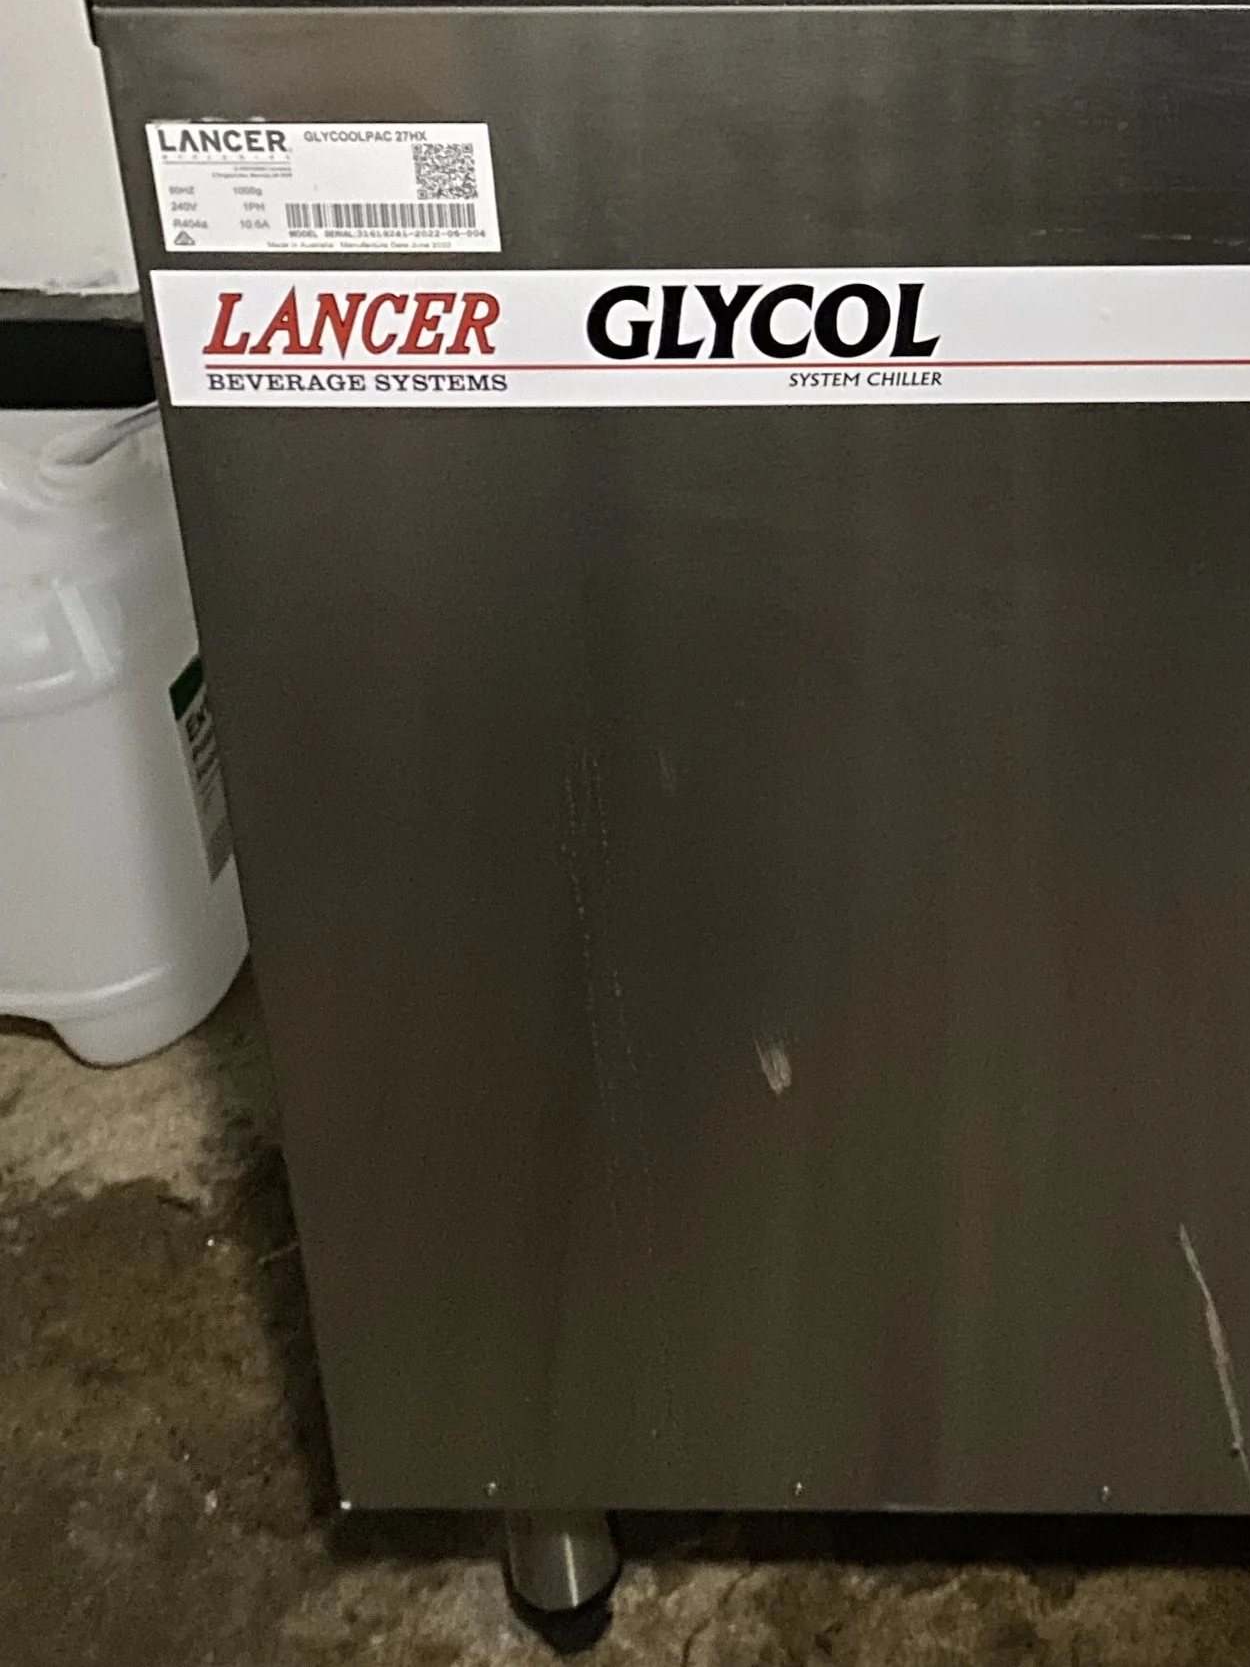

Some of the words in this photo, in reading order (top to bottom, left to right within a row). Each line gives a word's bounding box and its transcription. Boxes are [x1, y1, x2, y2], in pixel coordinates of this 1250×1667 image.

[158, 129, 287, 152] LANCER
[303, 130, 392, 142] GLYCOOLPAC
[395, 130, 427, 142] 27HX
[203, 285, 502, 361] LANCER
[586, 282, 942, 361] GLYCOL
[207, 373, 366, 393] BEVERAGE
[372, 373, 508, 393] SYSTEMS
[788, 371, 864, 388] SYSTEM
[869, 370, 943, 387] CHILLER
